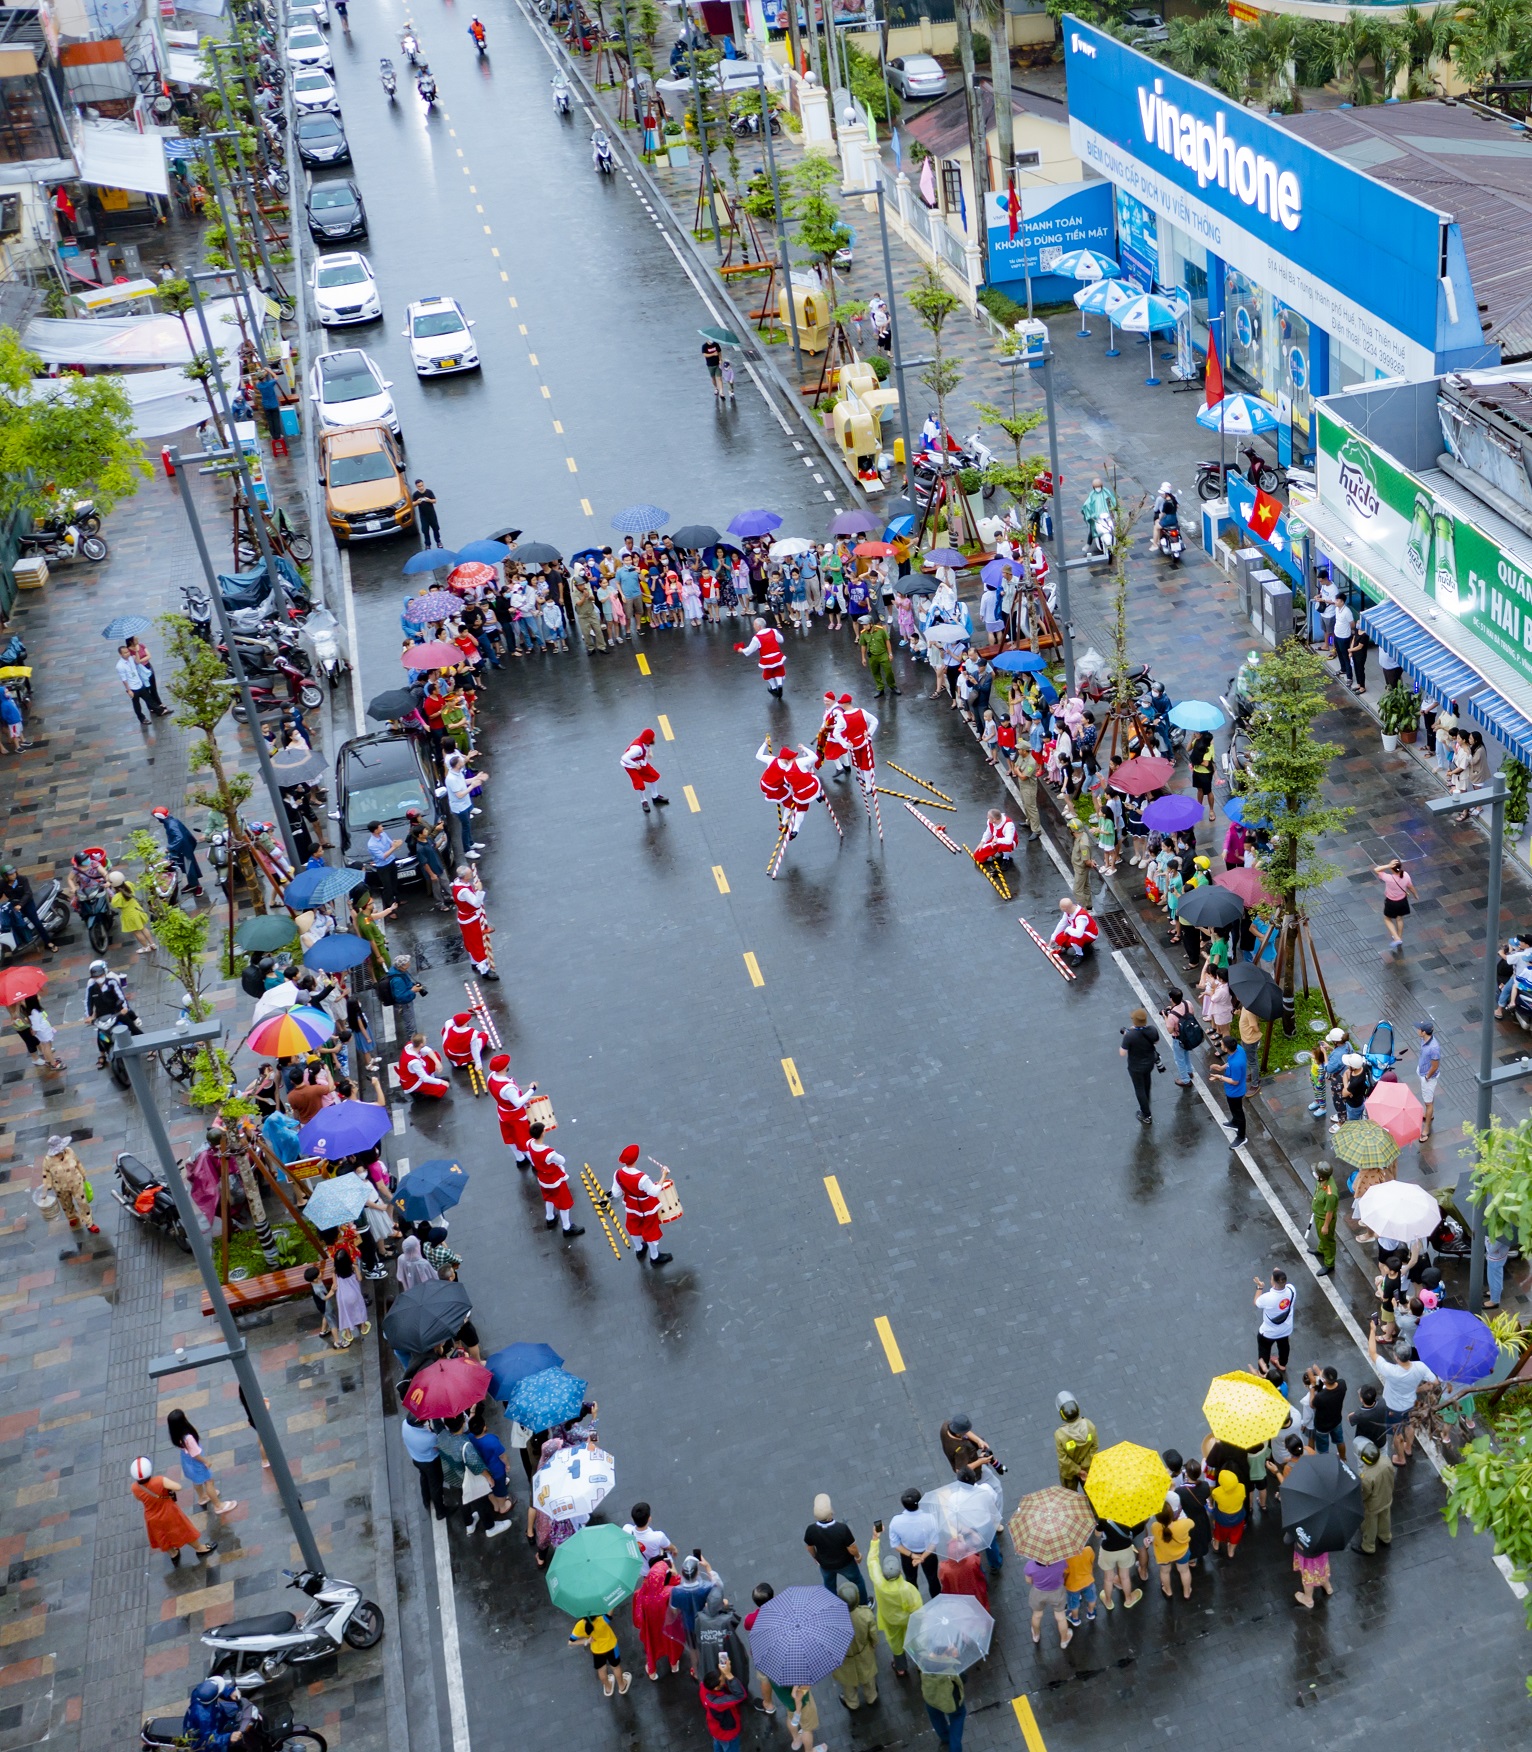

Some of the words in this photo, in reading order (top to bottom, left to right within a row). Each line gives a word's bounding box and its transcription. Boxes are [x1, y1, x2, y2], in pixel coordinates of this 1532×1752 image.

[1137, 78, 1302, 232] vinaphone
[1019, 221, 1053, 233] THANH
[1055, 216, 1083, 228] TOÁN
[1104, 152, 1124, 178] CUNG
[1125, 164, 1139, 188] CẤP
[1141, 177, 1159, 202] DỊCH
[1160, 190, 1171, 212] VỤ
[1172, 196, 1191, 225] VIỄN
[1192, 211, 1221, 245] THÔNG
[1034, 233, 1063, 246] DÙNG
[1065, 229, 1086, 242] TIỀN
[1088, 227, 1108, 240] MẶT
[1267, 258, 1278, 272] 51A
[1314, 288, 1331, 308] thành
[1331, 302, 1342, 318] phố
[1374, 327, 1391, 350] Thiên
[1392, 340, 1406, 360] Huế
[1331, 317, 1345, 335] Điện
[1362, 338, 1377, 358] 0234
[1338, 464, 1379, 518] huda
[1468, 570, 1486, 613] 51
[1490, 587, 1520, 642] HAI
[1480, 623, 1486, 633] 51
